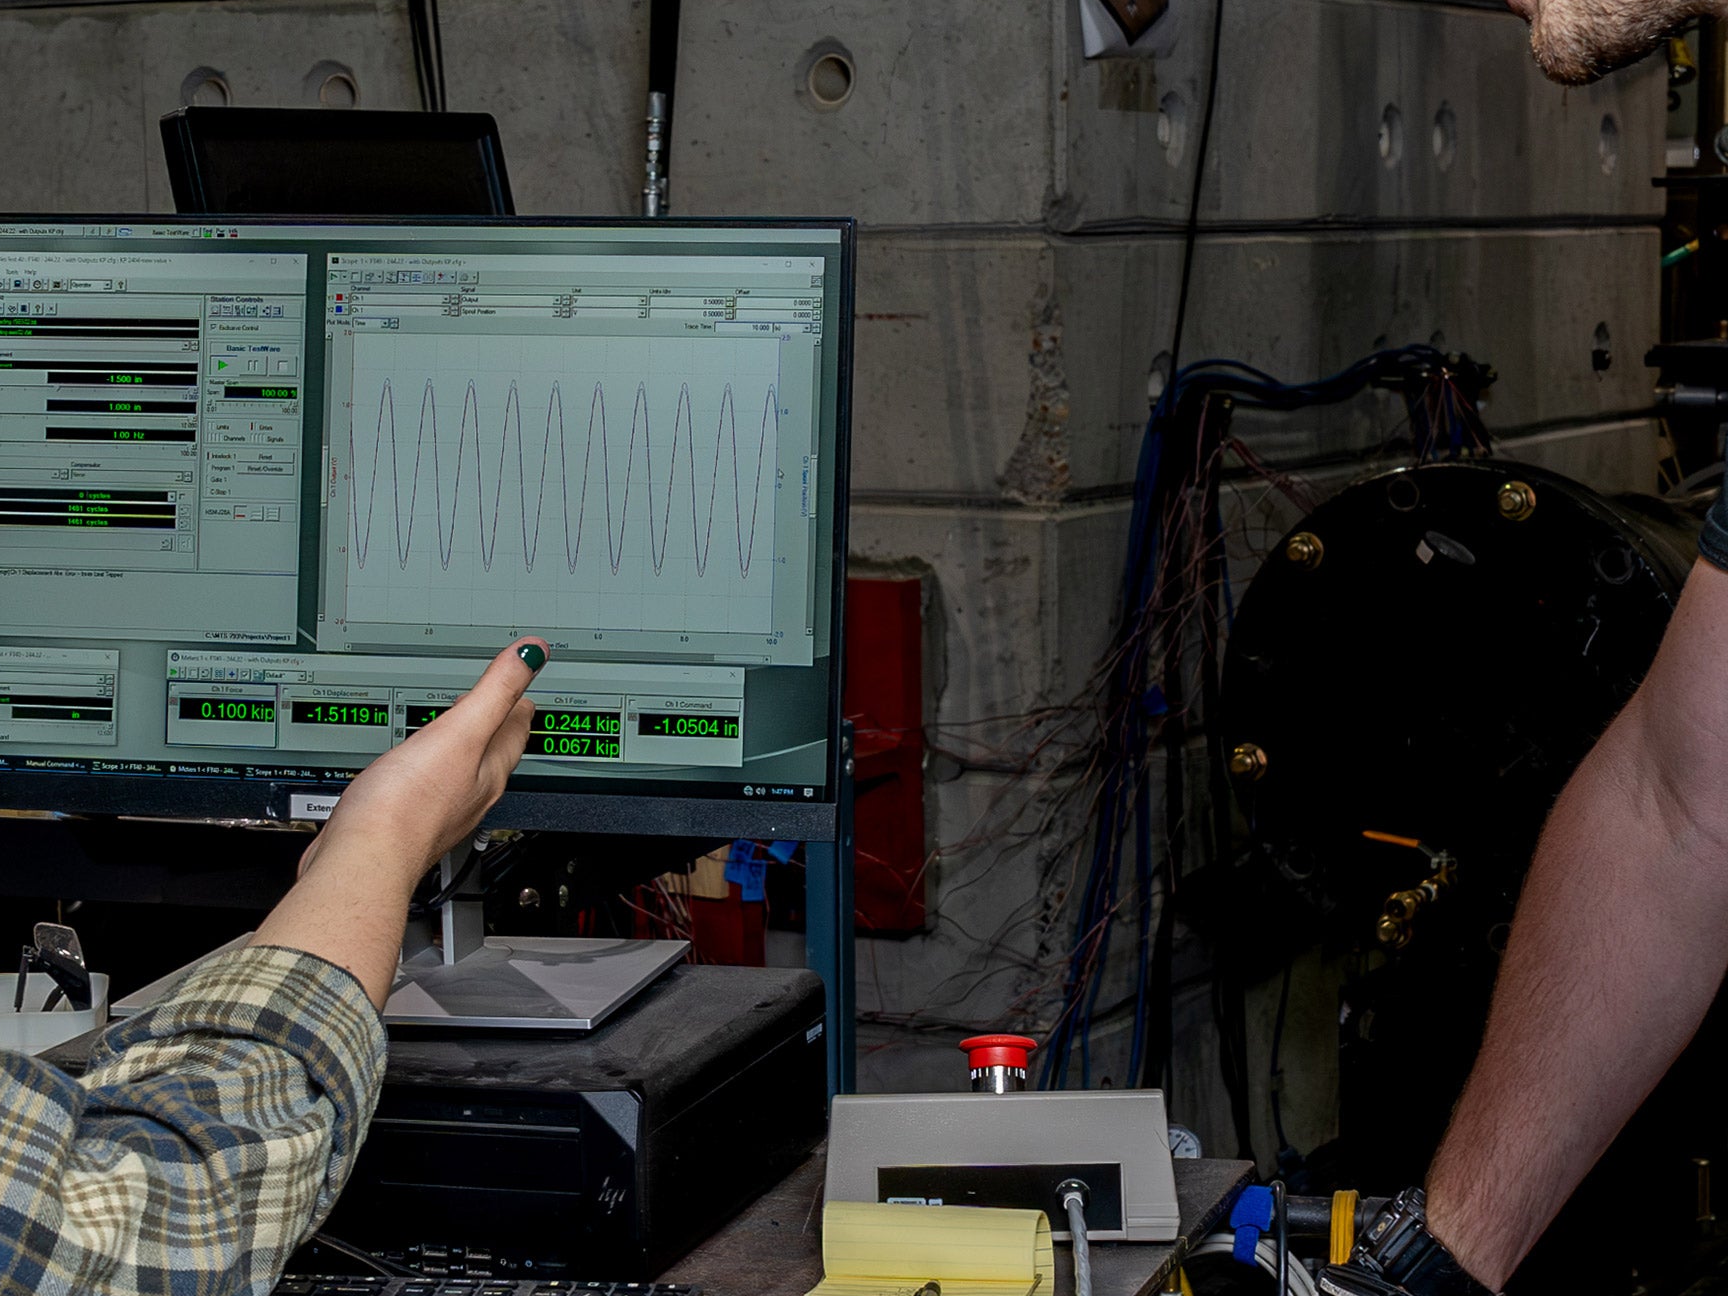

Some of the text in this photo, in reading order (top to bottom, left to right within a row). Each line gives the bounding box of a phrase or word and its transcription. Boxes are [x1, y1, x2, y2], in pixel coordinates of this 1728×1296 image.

[133, 431, 145, 440] Hz
[226, 686, 244, 694] Force
[327, 689, 369, 698] Displacement
[569, 696, 588, 705] Force
[680, 702, 713, 710] Command
[201, 702, 275, 723] 0.100 kip
[307, 706, 389, 724] -1.5119 in
[544, 714, 621, 735] 0.244 kip
[654, 718, 739, 738] -1.0504 in
[543, 738, 620, 758] 0.067 kip
[46, 760, 74, 768] Command
